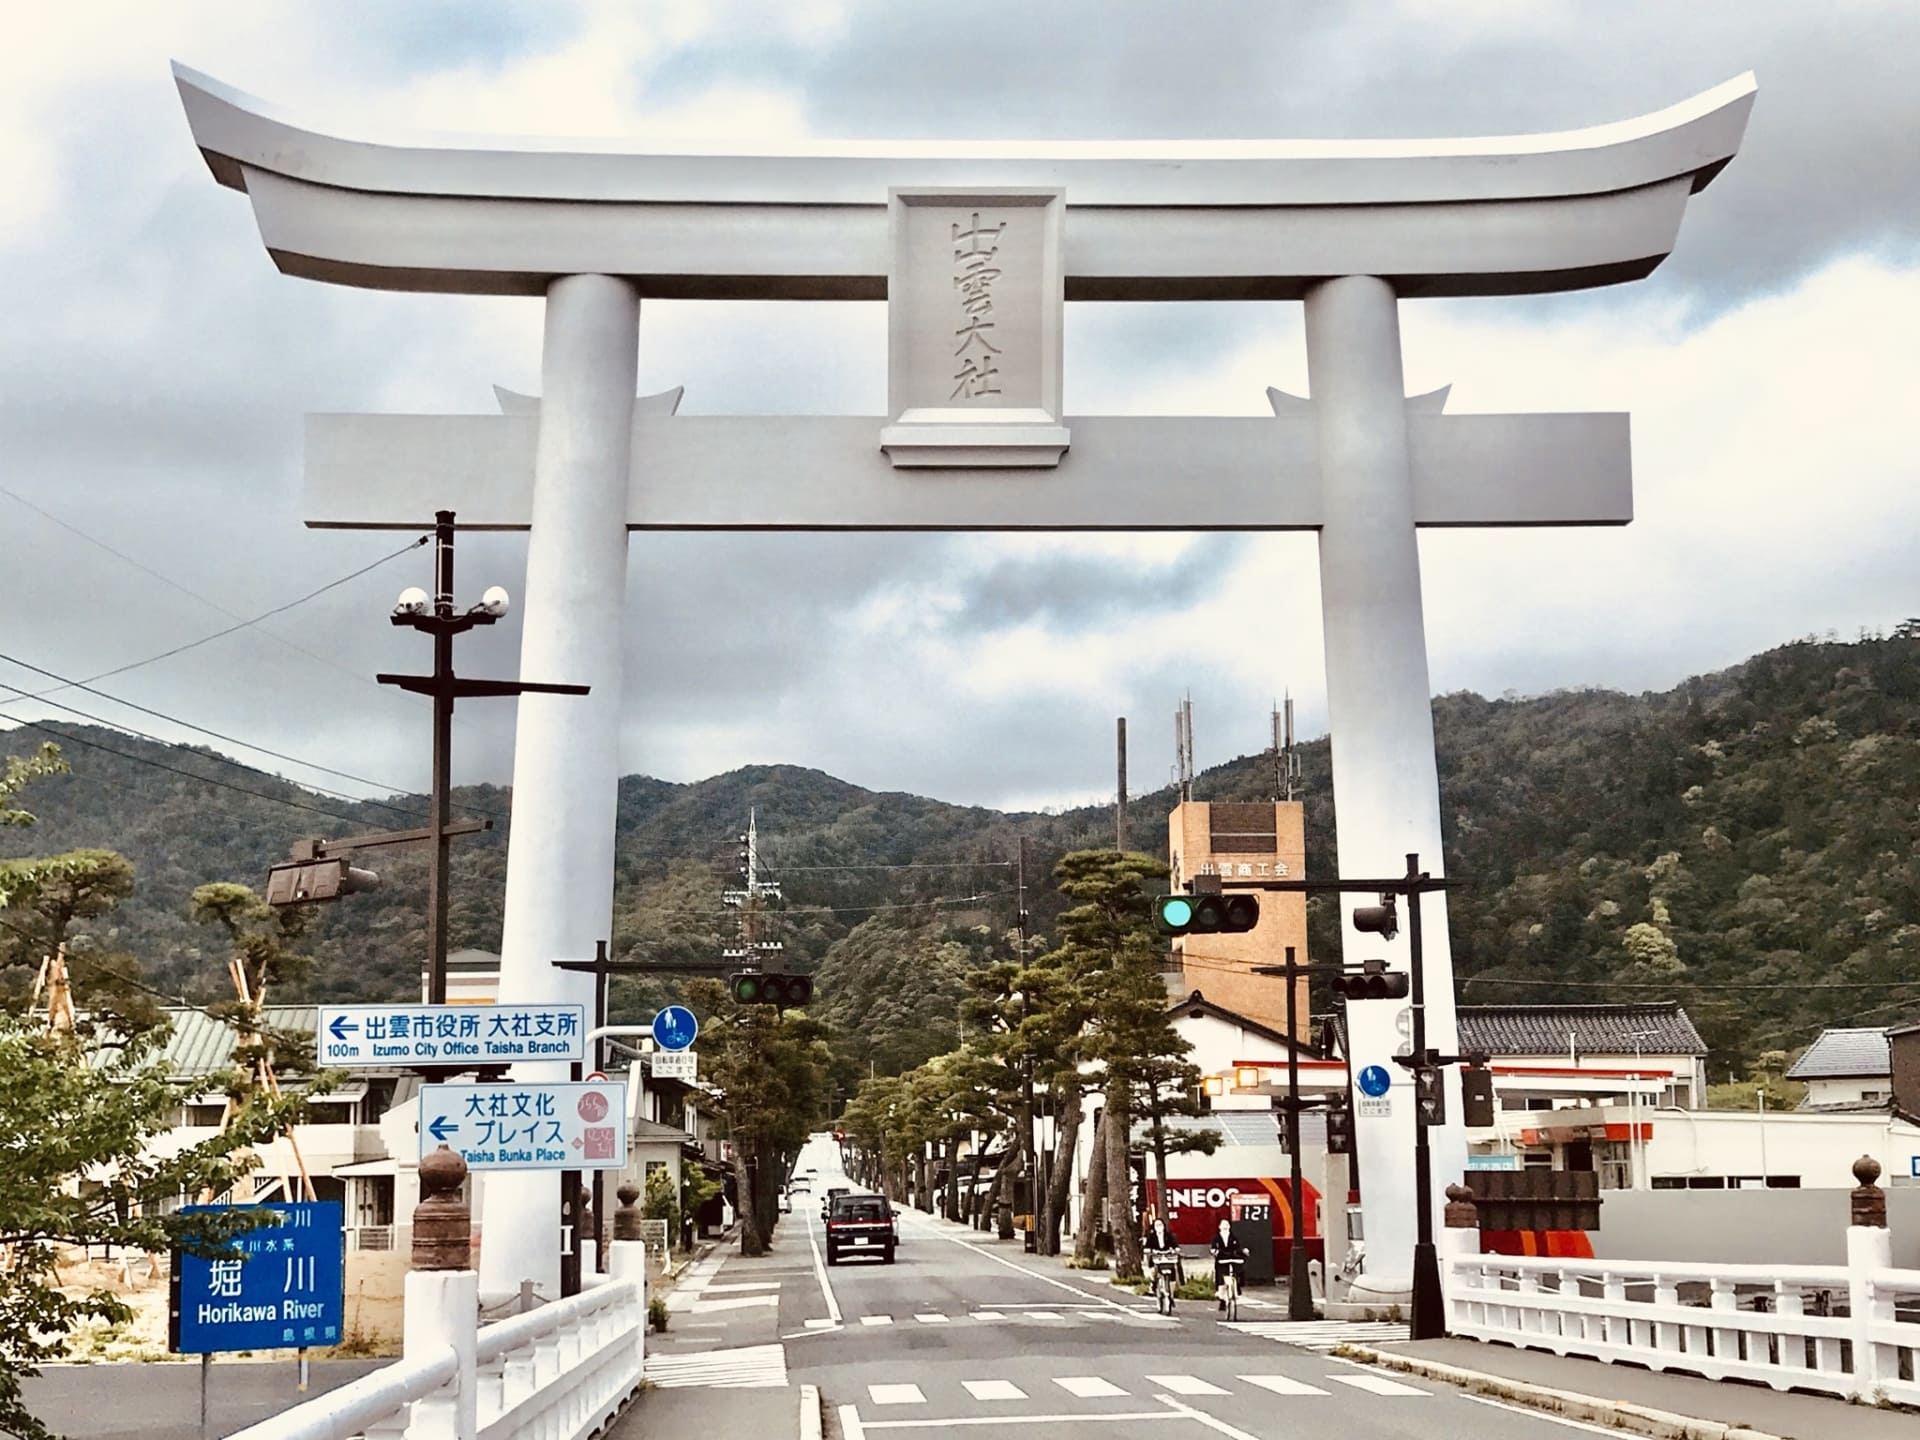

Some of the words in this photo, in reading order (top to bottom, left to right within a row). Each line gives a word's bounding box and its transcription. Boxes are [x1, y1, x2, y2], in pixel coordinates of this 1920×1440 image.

[950, 212, 1008, 400] 出雲大社
[1200, 862, 1290, 877] 出雲商工会
[366, 1014, 481, 1040] 出雲市役所
[488, 1012, 578, 1038] 大社支所
[327, 1043, 360, 1057] 100m
[373, 1043, 410, 1057] Izumo
[415, 1041, 438, 1059] City
[443, 1041, 479, 1056] Office
[485, 1041, 524, 1054] Taisha
[528, 1040, 571, 1054] Branch
[465, 1092, 556, 1118] 大社文化
[475, 1119, 564, 1146] プレイス
[461, 1149, 495, 1163] Taisha
[499, 1149, 532, 1161] Bunka
[536, 1148, 566, 1161] Place
[1244, 1205, 1269, 1221] 121
[208, 1256, 315, 1297] 堀川
[198, 1301, 277, 1324] Horikawa
[283, 1300, 325, 1319] River
